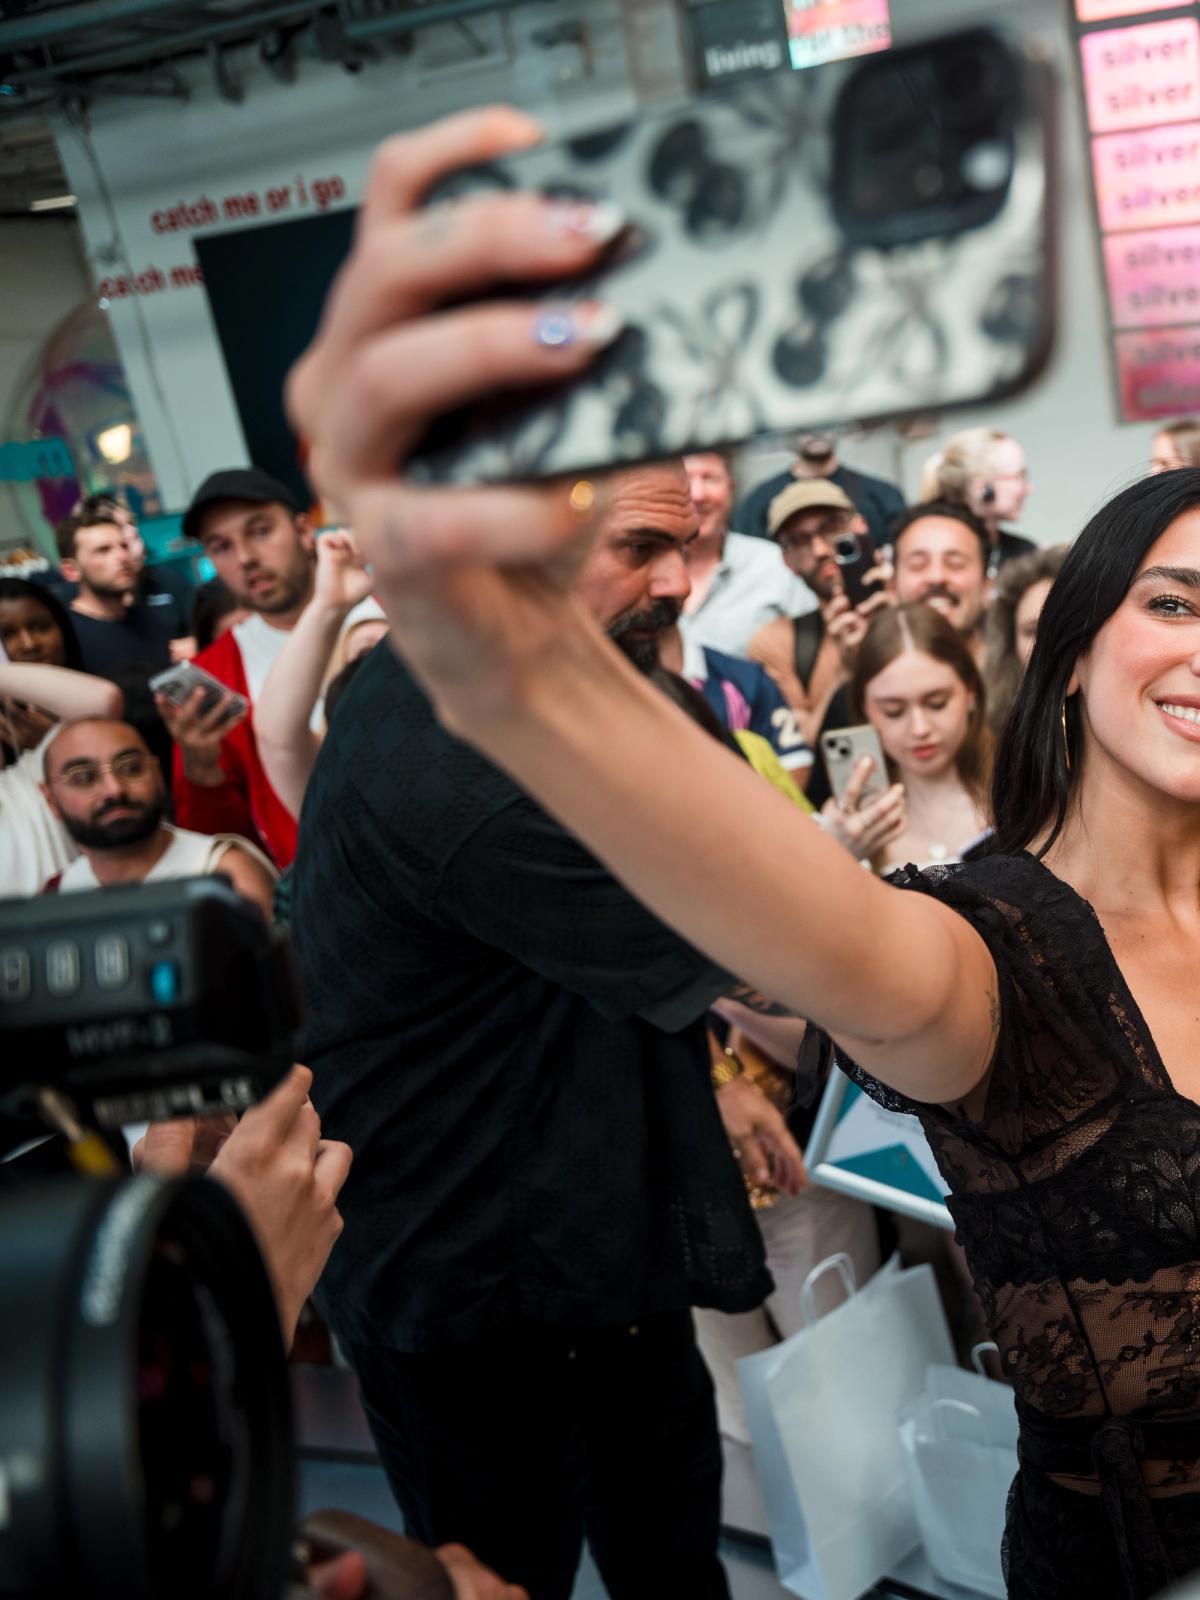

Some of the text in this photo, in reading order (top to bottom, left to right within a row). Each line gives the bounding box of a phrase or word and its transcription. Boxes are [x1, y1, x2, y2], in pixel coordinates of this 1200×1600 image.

[1103, 37, 1188, 67] silver
[1108, 82, 1192, 111] silver
[1116, 141, 1199, 170] silver
[152, 175, 346, 235] catch me or i go
